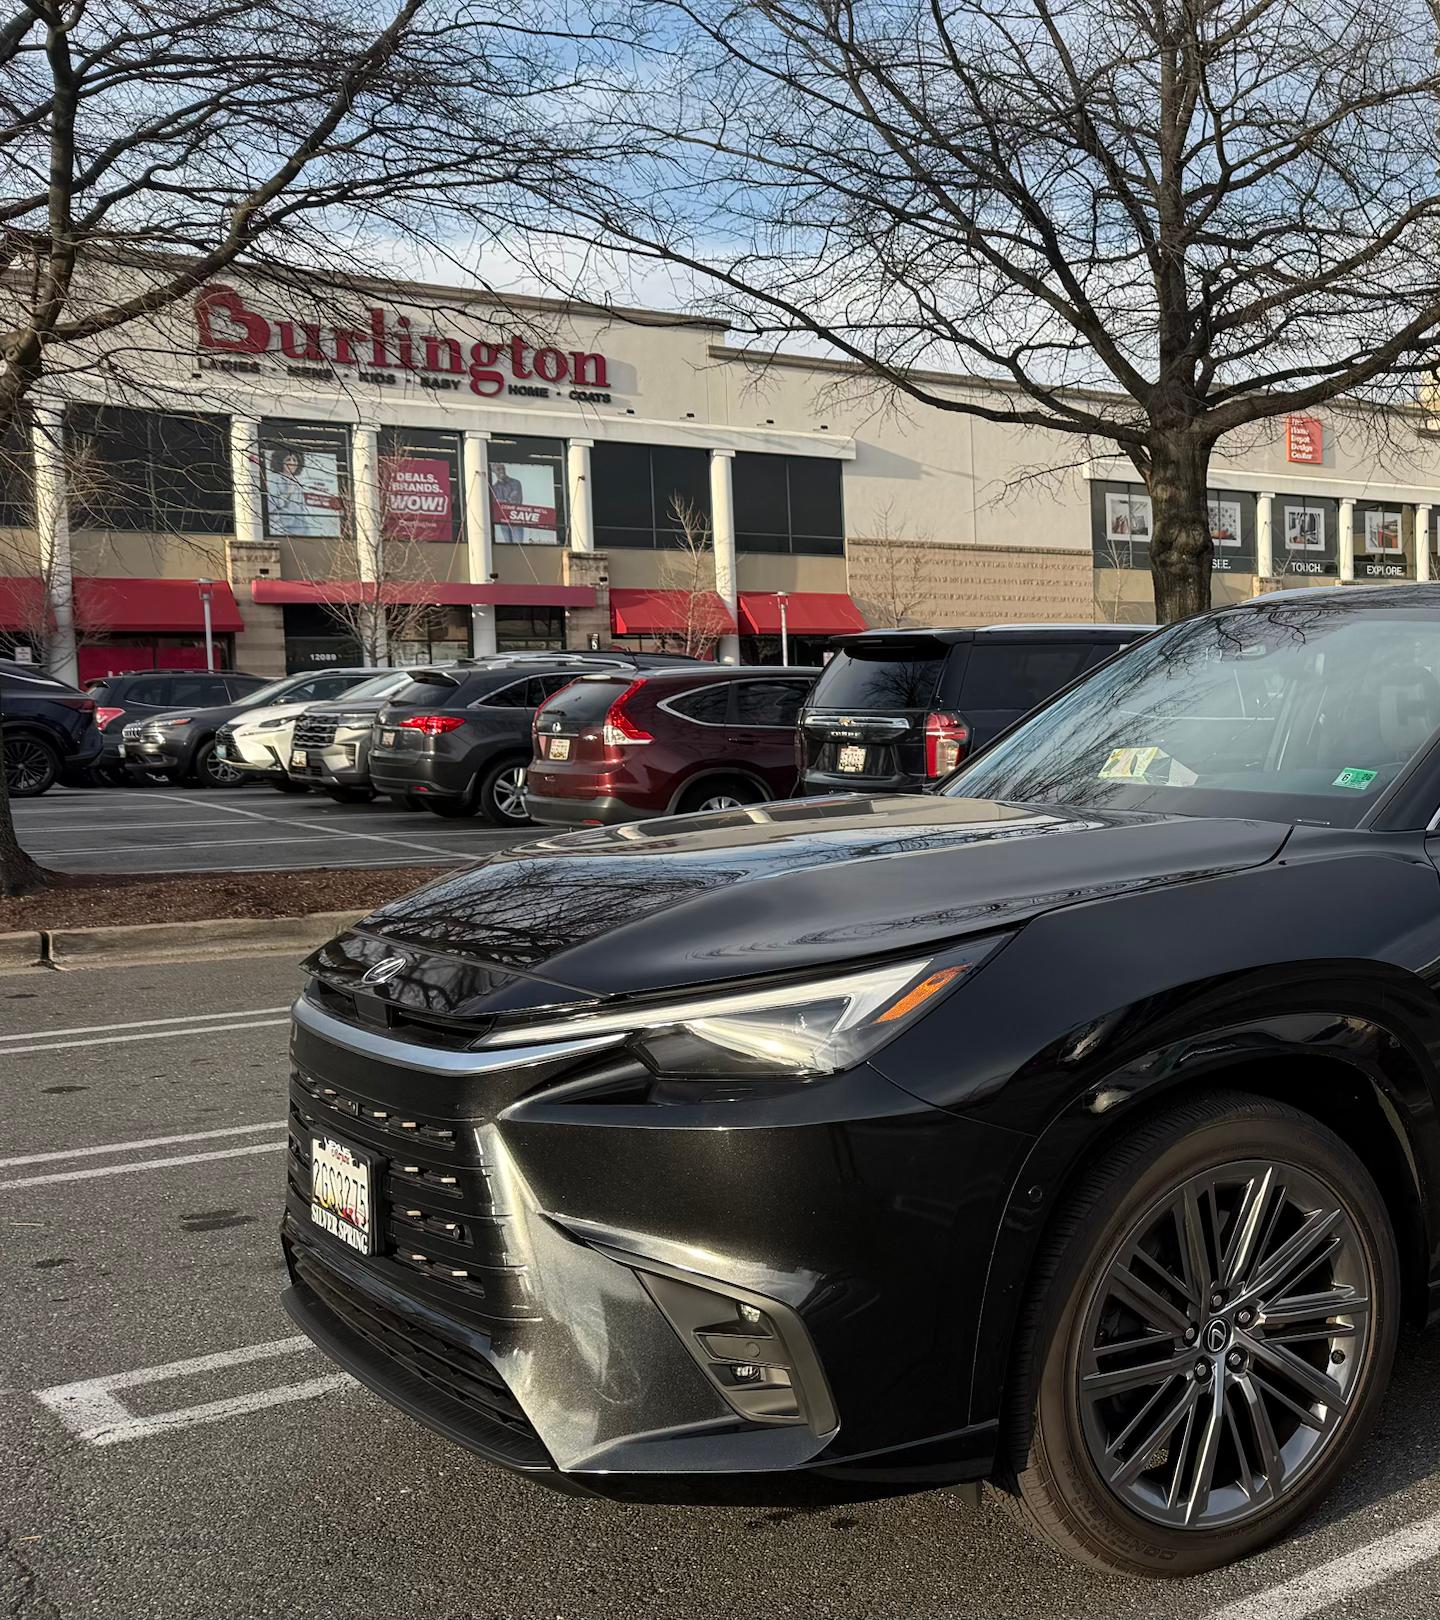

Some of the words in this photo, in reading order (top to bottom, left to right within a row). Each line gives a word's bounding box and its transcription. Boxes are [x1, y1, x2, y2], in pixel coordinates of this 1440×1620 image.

[195, 284, 611, 397] Burlington
[508, 384, 549, 398] HOME
[1291, 443, 1313, 453] Design
[1291, 451, 1313, 460] Center
[396, 472, 438, 483] DEALS.
[391, 482, 443, 493] BRANDS.
[390, 494, 444, 511] WOW!
[509, 510, 540, 522] SAVE
[1291, 561, 1323, 573] TOUCH.
[1366, 565, 1404, 576] EXPLORE.
[311, 1202, 338, 1237] SILVER
[338, 1219, 368, 1256] SPRING
